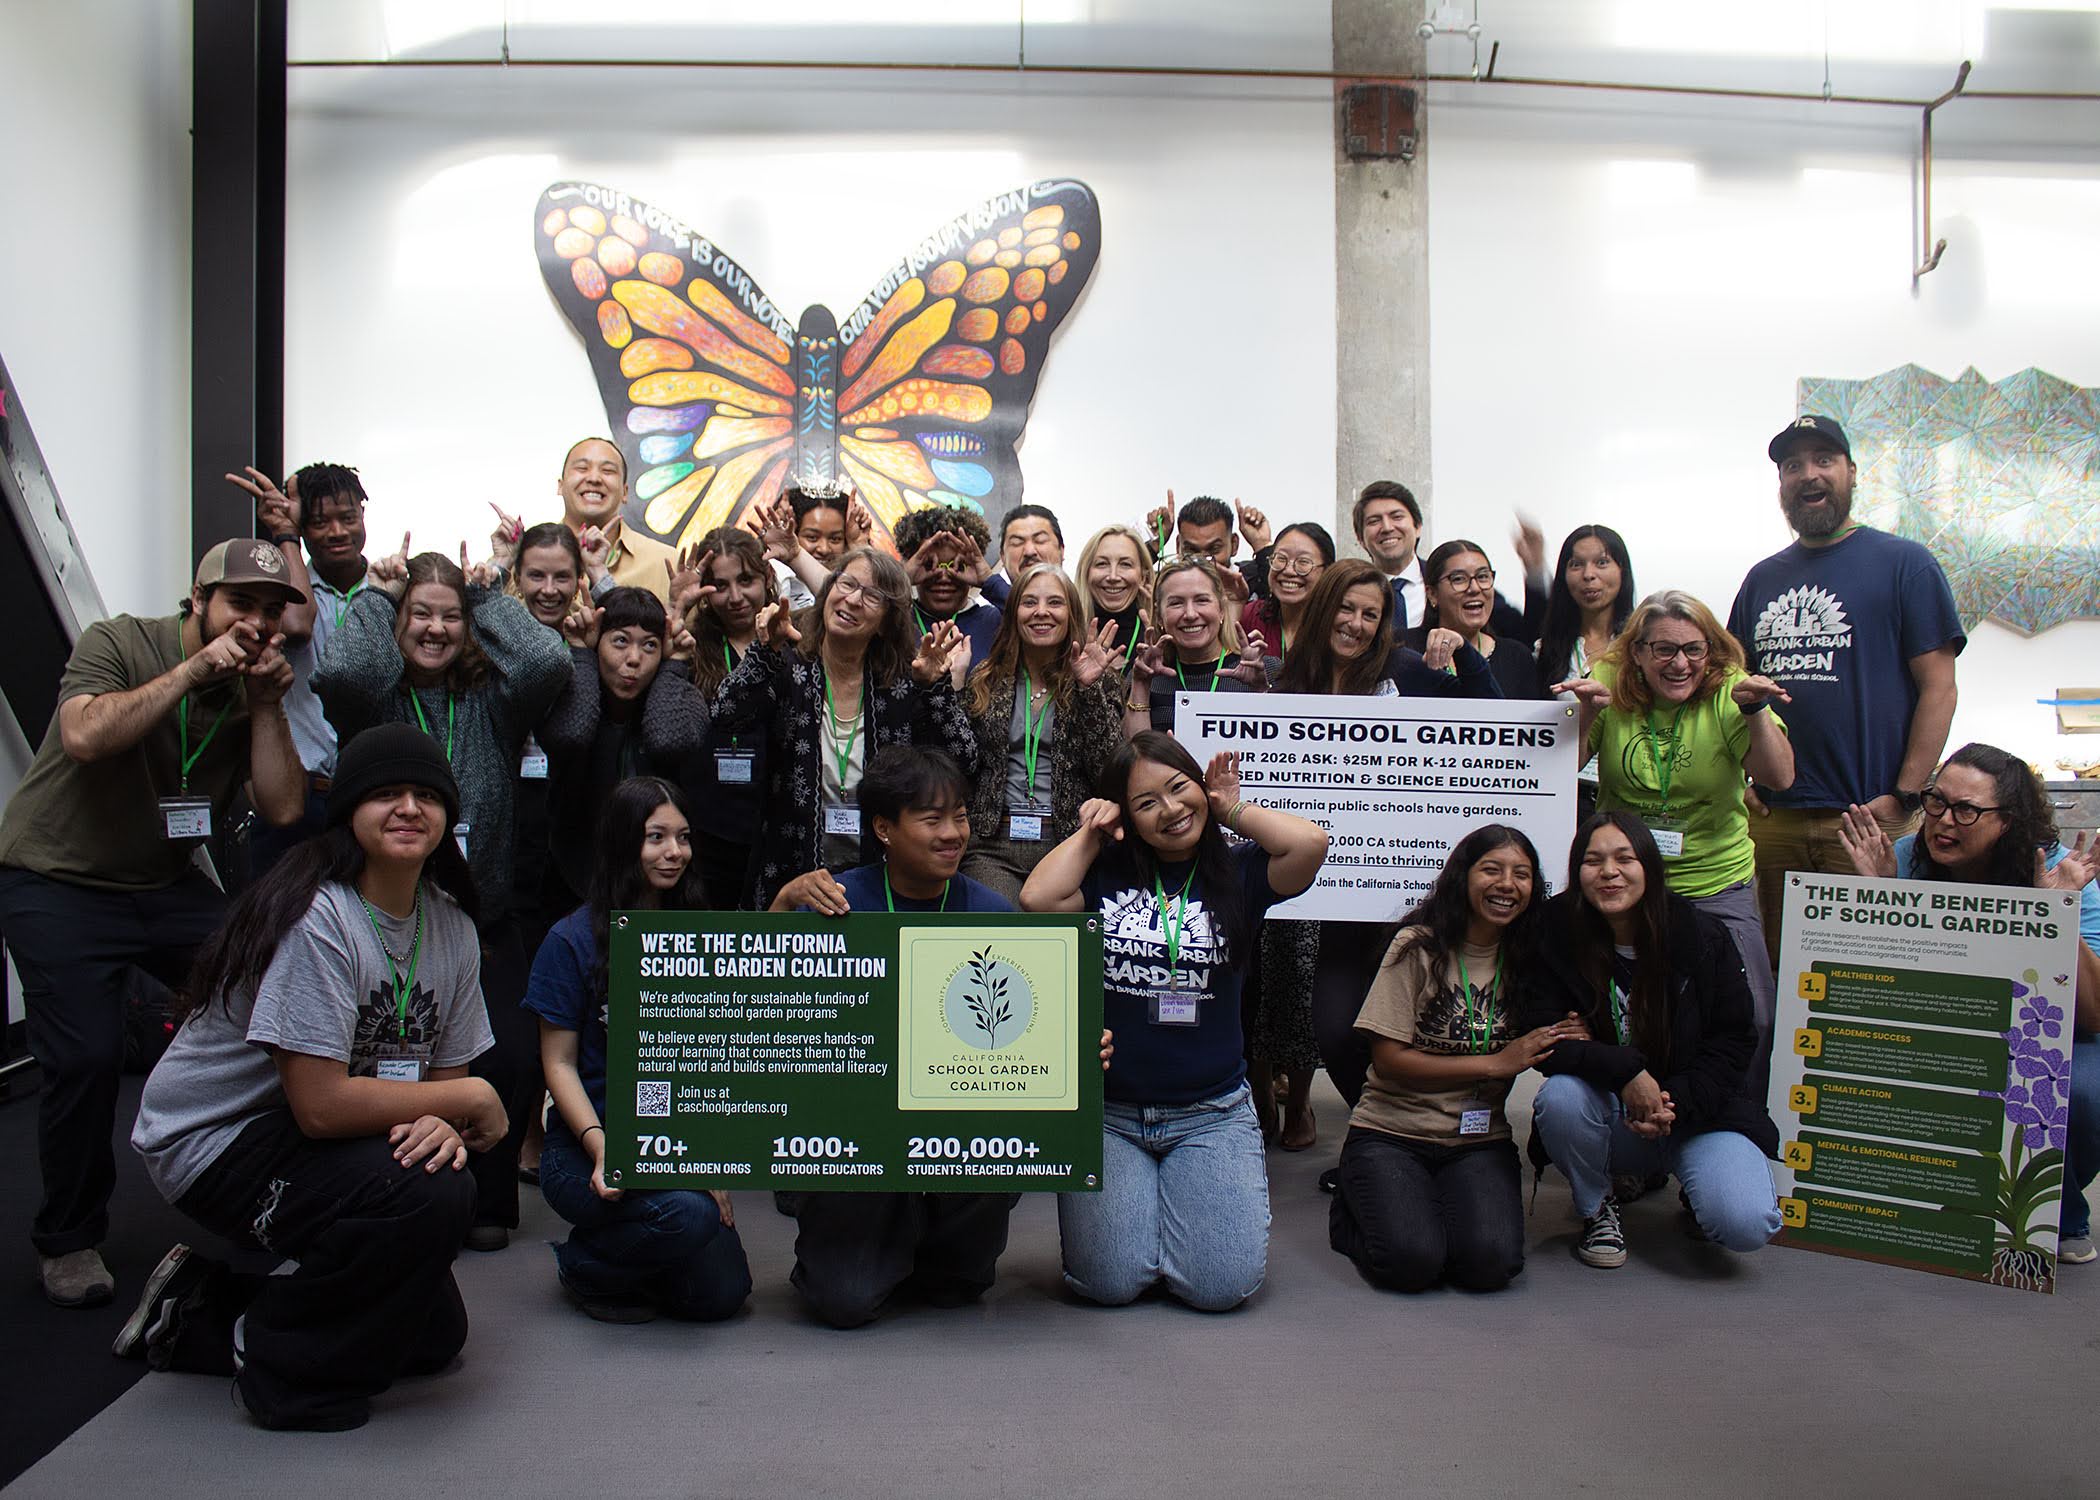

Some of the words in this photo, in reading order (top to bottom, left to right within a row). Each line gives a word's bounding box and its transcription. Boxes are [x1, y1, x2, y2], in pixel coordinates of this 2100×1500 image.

[584, 184, 632, 217] OUR
[634, 203, 692, 248] VOICE
[691, 238, 712, 266] IS
[712, 255, 752, 307] OUR
[749, 292, 795, 347] VOTE
[839, 304, 876, 345] OUR
[867, 269, 911, 310] VOTE
[905, 252, 927, 277] IS
[924, 226, 965, 264] OUR
[953, 188, 1030, 241] VISION
[1806, 633, 1852, 649] URBAN
[1760, 651, 1834, 673] GARDEN
[1201, 719, 1279, 739] FUND
[1288, 721, 1407, 743] SCHOOL
[1416, 725, 1556, 747] GARDENS
[1260, 752, 1296, 763] 2026
[1301, 753, 1337, 764] ASK:
[1342, 753, 1382, 766] $25M
[1387, 755, 1417, 767] FOR
[1423, 756, 1456, 768] K-12
[1461, 757, 1530, 770] GARDEN-
[1269, 771, 1354, 784] NUTRITION
[1360, 773, 1372, 784] &
[1376, 774, 1444, 786] SCIENCE
[1449, 776, 1538, 789] EDUCATION
[1260, 798, 1325, 810] California
[1328, 800, 1369, 813] public
[1372, 801, 1423, 813] schools
[1426, 802, 1460, 814] have
[1462, 804, 1522, 818] gardens.
[1366, 836, 1385, 847] CA
[1388, 837, 1451, 851] students,
[1363, 854, 1389, 865] into
[1392, 855, 1445, 870] thriving
[1316, 877, 1337, 888] Join
[1338, 877, 1353, 888] the
[1355, 877, 1401, 889] California
[1403, 880, 1435, 890] School
[1405, 897, 1415, 906] at
[1804, 884, 1849, 902] THE
[1856, 888, 1923, 907] MANY
[1930, 893, 2049, 917] BENEFITS
[1803, 904, 1833, 920] OF
[1839, 907, 1933, 929] SCHOOL
[1941, 915, 2058, 939] GARDENS
[641, 933, 696, 953] WE'RE
[701, 933, 736, 953] THE
[741, 933, 846, 953] CALIFORNIA
[1801, 929, 1831, 937] Extensive
[1831, 932, 1860, 940] research
[1860, 935, 1898, 943] establishes
[1911, 939, 1938, 947] positive
[1939, 941, 1968, 950] impacts
[1103, 939, 1165, 959] RBANK
[640, 956, 709, 977] SCHOOL
[714, 956, 785, 977] GARDEN
[790, 957, 885, 977] COALITION
[1831, 970, 1873, 981] HEALTHIER
[1875, 974, 1895, 983] KIDS
[992, 954, 1035, 989] EXPERIENTIAL
[1026, 991, 1039, 1033] LEARNING
[1116, 985, 1158, 999] BURBANK
[1804, 979, 1820, 992] 1.
[639, 990, 668, 1003] We're
[670, 990, 729, 1007] advocating
[732, 990, 748, 1004] for
[750, 991, 812, 1004] sustainable
[814, 991, 855, 1007] funding
[858, 991, 869, 1004] of
[639, 1004, 706, 1018] instructional
[708, 1005, 743, 1018] school
[745, 1005, 783, 1021] garden
[786, 1008, 837, 1021] programs
[638, 1030, 655, 1043] We
[657, 1030, 695, 1044] believe
[697, 1033, 727, 1048] every
[729, 1031, 770, 1044] student
[773, 1031, 821, 1044] deserves
[824, 1031, 874, 1045] hands-on
[1799, 1035, 1816, 1049] 2.
[1827, 1027, 1871, 1039] ACADEMIC
[1872, 1032, 1911, 1043] SUCCESS
[638, 1044, 680, 1058] outdoor
[682, 1044, 725, 1061] learning
[728, 1045, 750, 1058] that
[752, 1046, 802, 1058] connects
[804, 1045, 832, 1059] them
[834, 1046, 846, 1059] to
[848, 1045, 866, 1058] the
[952, 1054, 1024, 1062] CALIFORNIA
[637, 1059, 675, 1072] natural
[678, 1059, 707, 1072] world
[710, 1059, 730, 1072] and
[733, 1059, 765, 1072] builds
[767, 1059, 844, 1073] environmental
[847, 1060, 887, 1076] literacy
[927, 1064, 984, 1075] SCHOOL
[990, 1064, 1048, 1075] GARDEN
[677, 1085, 700, 1098] Join
[703, 1088, 716, 1098] us
[718, 1086, 730, 1098] at
[950, 1081, 1026, 1091] COALITION
[1822, 1084, 1857, 1096] CLIMATE
[1859, 1088, 1892, 1099] ACTION
[1794, 1091, 1811, 1106] 3.
[677, 1099, 787, 1116] caschoolgardens.org
[637, 1136, 687, 1155] 70+
[773, 1137, 858, 1157] 1000+
[908, 1137, 1039, 1162] 200,000+
[1817, 1140, 1850, 1152] MENTAL
[1851, 1145, 1857, 1153] &
[1859, 1146, 1909, 1161] EMOTIONAL
[1910, 1155, 1957, 1168] RESILIENCE
[1788, 1148, 1806, 1163] 4.
[635, 1162, 677, 1173] SCHOOL
[678, 1162, 721, 1174] GARDEN
[723, 1162, 751, 1174] ORGS
[770, 1163, 820, 1174] OUTDOOR
[822, 1163, 883, 1175] EDUCATORS
[907, 1164, 962, 1175] STUDENTS
[964, 1164, 1013, 1175] REACHED
[1015, 1164, 1072, 1175] ANNUALLY
[1784, 1205, 1801, 1219] 5.
[1812, 1197, 1864, 1213] COMMUNITY
[1865, 1205, 1899, 1218] IMPACT
